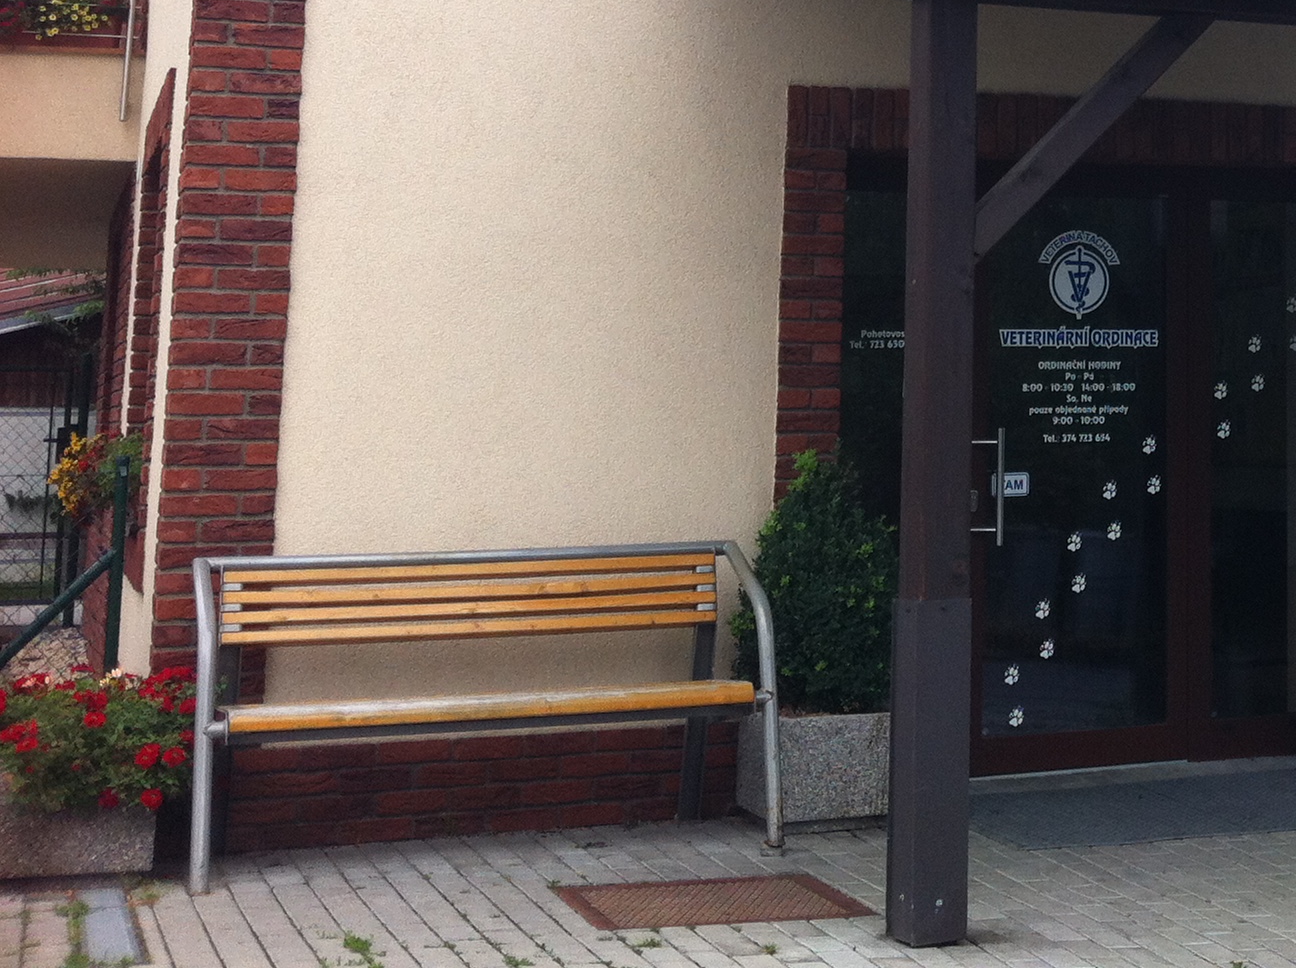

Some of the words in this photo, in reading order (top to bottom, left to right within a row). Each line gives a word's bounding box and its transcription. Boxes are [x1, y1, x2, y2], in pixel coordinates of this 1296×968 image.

[1040, 231, 1084, 263] VETERINA
[1084, 232, 1118, 264] TACHOV
[999, 326, 1090, 348] VETERINÁRNÍ
[1091, 330, 1158, 348] ORDINACE
[1038, 360, 1086, 370] ORDINAČNÍ
[1088, 360, 1121, 370] HODINY
[1065, 372, 1076, 381] Po
[1022, 383, 1043, 392] 8:00
[1050, 383, 1074, 392] 10:30
[1081, 383, 1105, 392] 14:00
[1112, 383, 1136, 392] 18:00
[1081, 394, 1092, 403] Ne
[1028, 407, 1053, 416] pouze
[1055, 405, 1096, 416] objednané
[1052, 416, 1073, 425] 9:00
[1080, 416, 1105, 425] 10:00
[1004, 479, 1024, 491] AM
